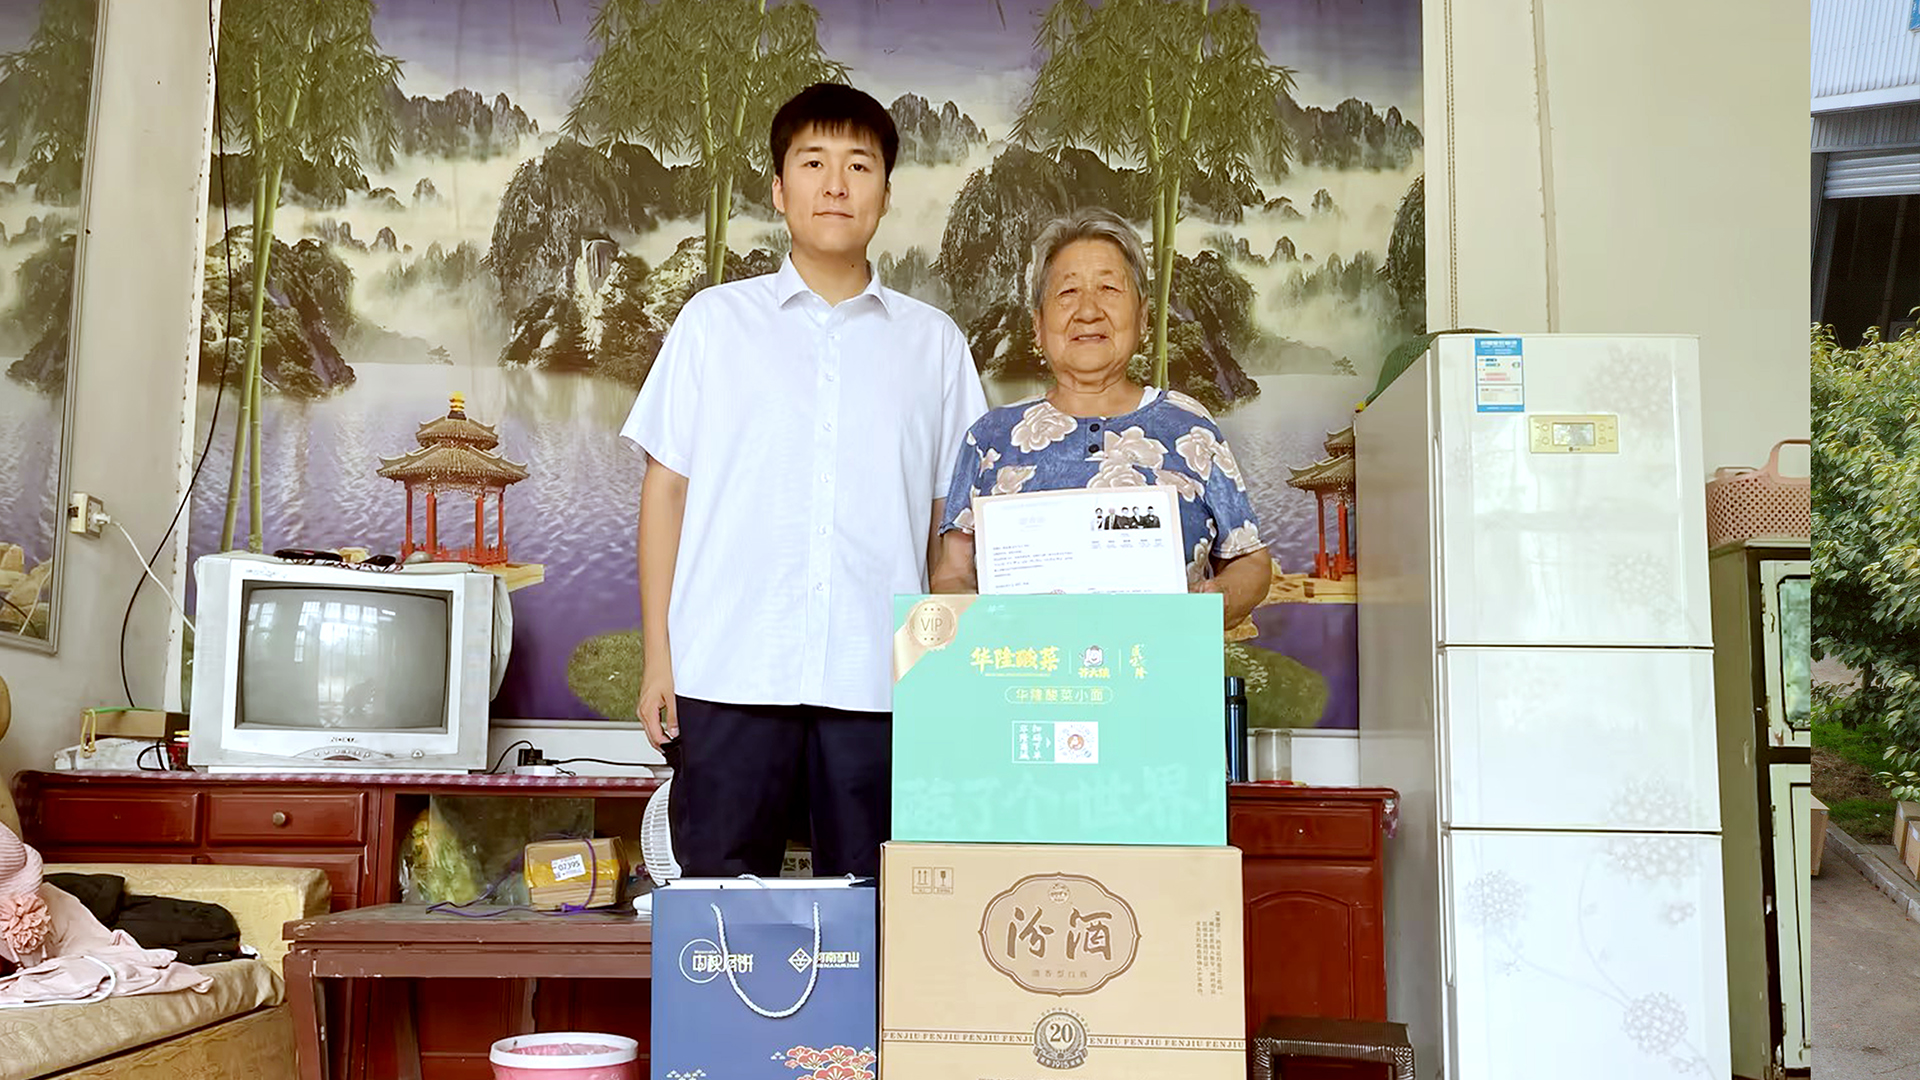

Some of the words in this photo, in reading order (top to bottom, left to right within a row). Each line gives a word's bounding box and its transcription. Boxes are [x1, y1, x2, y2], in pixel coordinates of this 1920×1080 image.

[920, 617, 944, 631] VIP
[1015, 687, 1104, 702] 华隆酸菜小面
[1007, 906, 1113, 960] 汾酒
[883, 1031, 920, 1040] FENJIU
[923, 1032, 960, 1041] FENJIU
[963, 1033, 1000, 1042] FENJIU
[1050, 1022, 1074, 1044] 20
[1123, 1038, 1161, 1046] FENJIU
[1164, 1039, 1203, 1047] FENJIU
[1205, 1040, 1245, 1048] FENJIU
